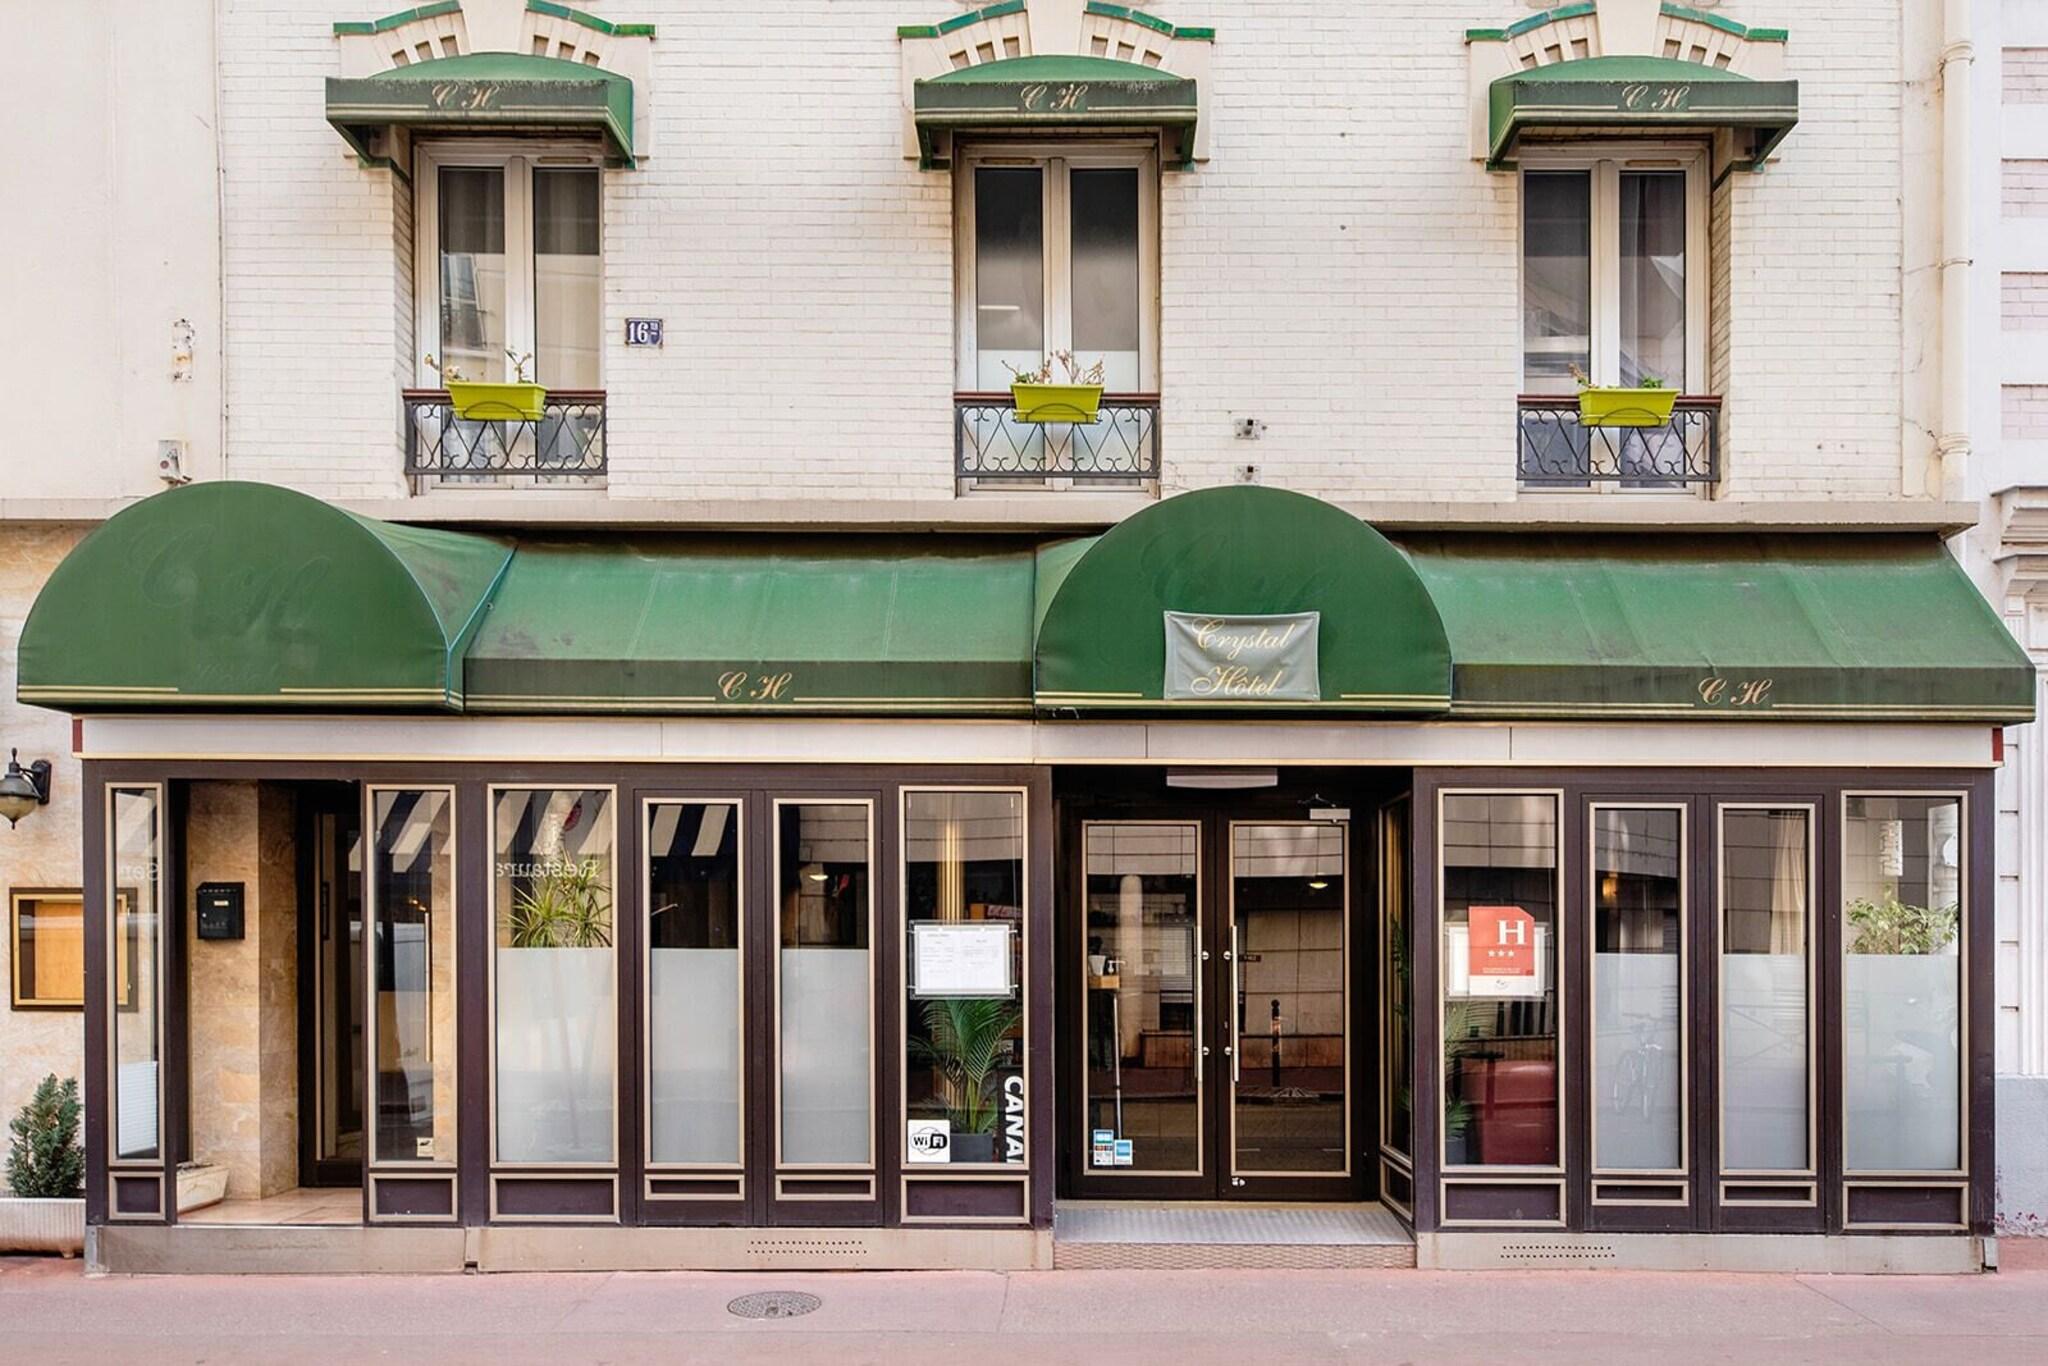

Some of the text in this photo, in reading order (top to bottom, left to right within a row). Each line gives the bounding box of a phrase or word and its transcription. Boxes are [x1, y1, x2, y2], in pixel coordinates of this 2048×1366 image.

[432, 82, 459, 109] C
[1021, 83, 1089, 111] C H
[1622, 84, 1690, 111] C H
[1191, 617, 1295, 661] Crystal
[718, 671, 793, 700] C H
[1190, 664, 1283, 696] Hôtel
[1698, 677, 1773, 705] C H
[1497, 919, 1526, 946] H
[1004, 1075, 1024, 1163] CANA
